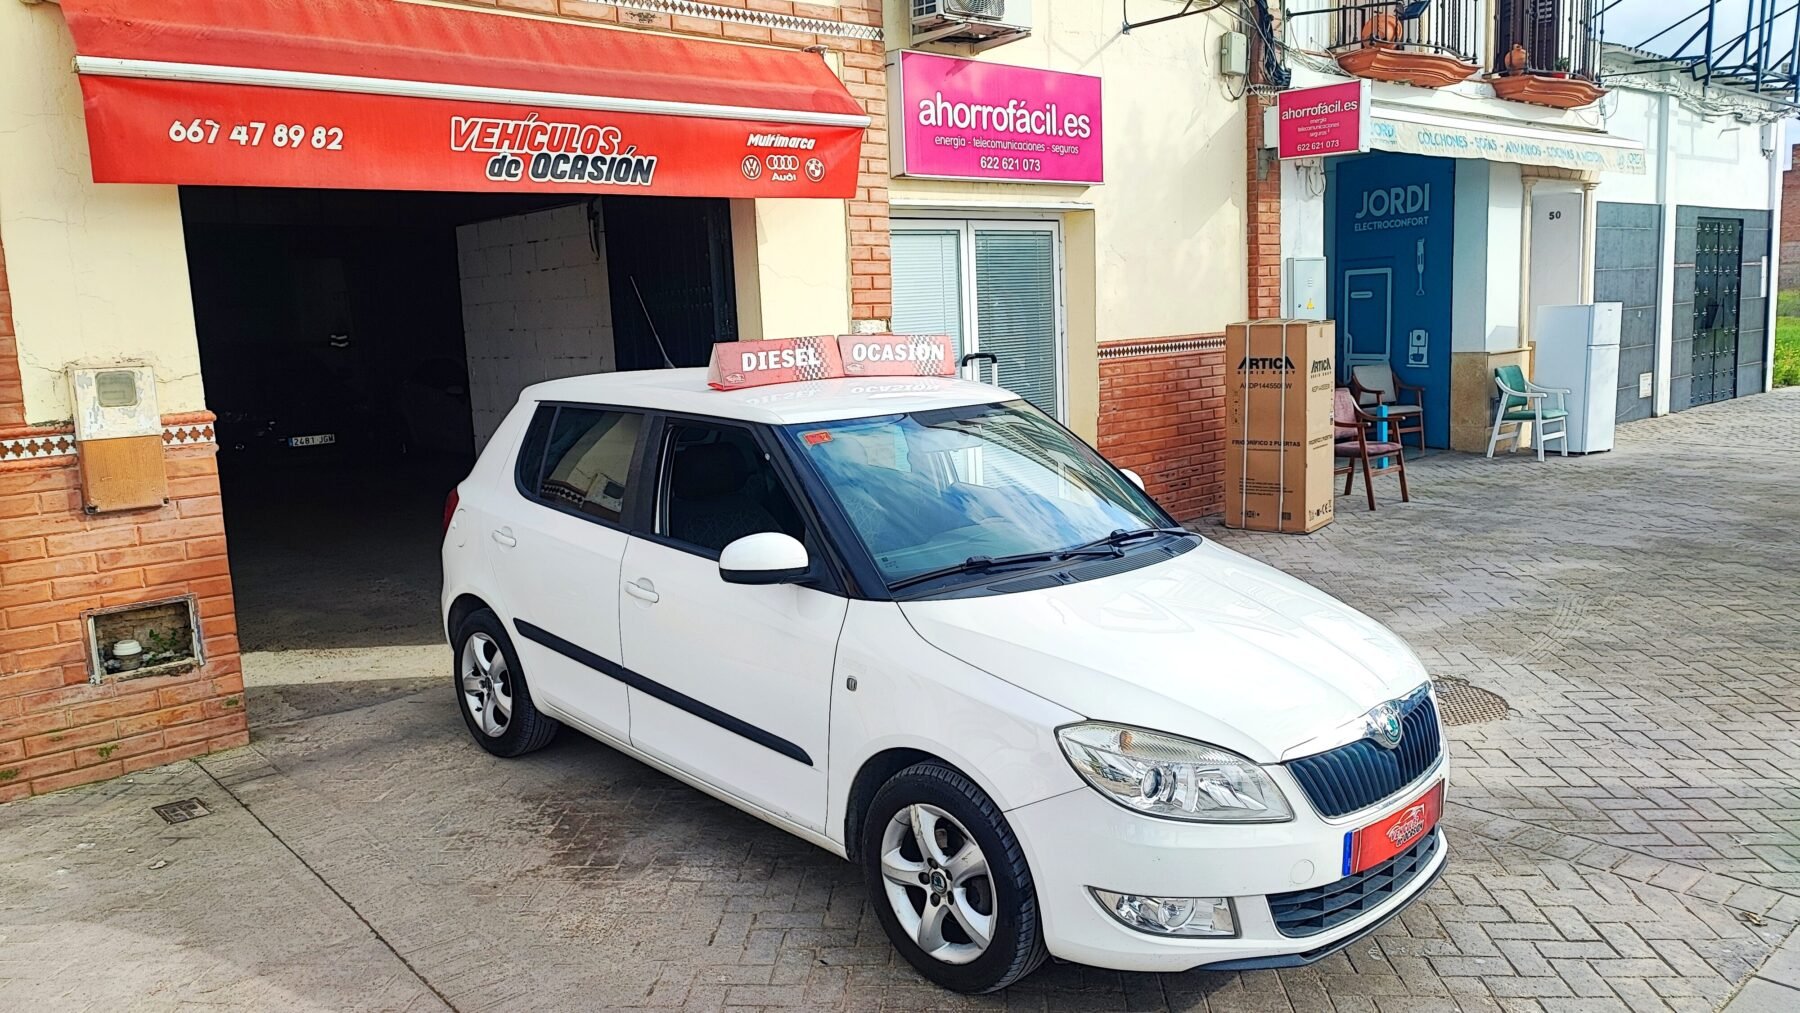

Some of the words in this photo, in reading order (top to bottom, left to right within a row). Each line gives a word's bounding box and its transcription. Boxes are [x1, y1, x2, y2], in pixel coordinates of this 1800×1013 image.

[918, 91, 1091, 138] ahorrofácil.es
[1282, 100, 1358, 120] ahorrofácil.es
[169, 118, 221, 144] 667
[229, 121, 266, 146] 47
[272, 123, 305, 148] 89
[311, 126, 344, 150] 82
[451, 113, 621, 155] VEHÍCULOS
[747, 133, 816, 149] Multimarca
[1417, 131, 1468, 148] COLCHONES
[973, 137, 1045, 152] telecomunicaciones
[1051, 144, 1079, 156] seguros
[1297, 143, 1310, 151] 622
[1311, 142, 1324, 150] 621
[1326, 139, 1339, 148] 073
[486, 154, 523, 179] de
[530, 146, 656, 184] OCASIÓN
[980, 156, 999, 169] 622
[1002, 157, 1019, 170] 621
[1022, 158, 1041, 172] 073
[772, 172, 796, 181] Audi
[1355, 183, 1430, 219] JORDI
[1548, 210, 1561, 220] 50
[1354, 216, 1429, 232] ELECTROCONFORT
[741, 347, 821, 372] DIESEL
[1237, 356, 1295, 369] ARTICA
[1311, 357, 1331, 373] ARTICA
[294, 437, 314, 446] 2481
